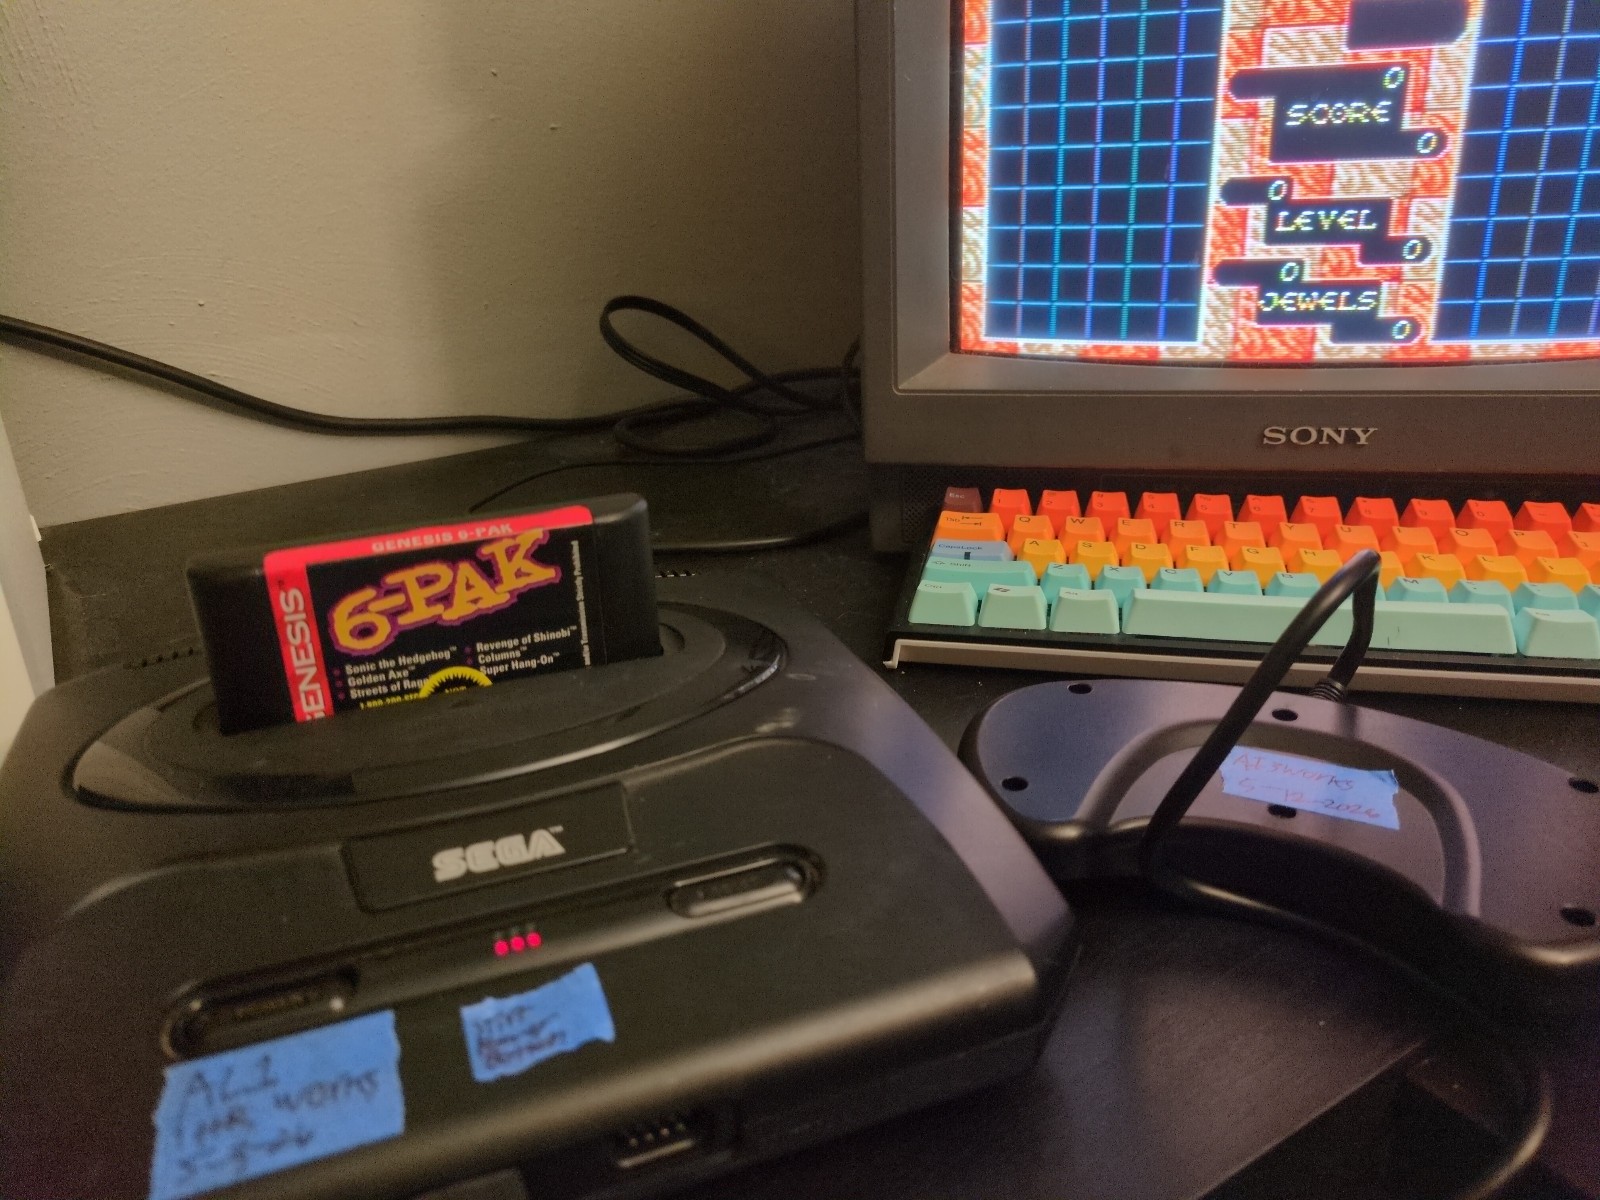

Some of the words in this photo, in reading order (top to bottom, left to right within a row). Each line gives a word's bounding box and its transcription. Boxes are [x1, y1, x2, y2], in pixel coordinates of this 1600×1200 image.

[1285, 101, 1392, 126] SCORE
[1275, 210, 1378, 232] LEVEL
[1260, 291, 1379, 313] JEWELS
[1263, 426, 1379, 446] SONY
[372, 532, 453, 554] GENESIS
[458, 524, 513, 540] 6-PAK
[330, 528, 559, 655] 6-PAK
[476, 638, 519, 653] Revenge
[521, 634, 532, 645] of
[533, 628, 572, 643] Shinobi
[279, 588, 325, 720] ENESIS
[477, 649, 521, 665] Columns
[510, 653, 554, 671] Hang-On
[345, 661, 376, 676] Sonic
[378, 658, 397, 669] the
[348, 673, 386, 688] Golden
[388, 668, 410, 681] Axe
[351, 685, 389, 701] Streets
[391, 682, 401, 693] of
[432, 828, 566, 883] SEGA
